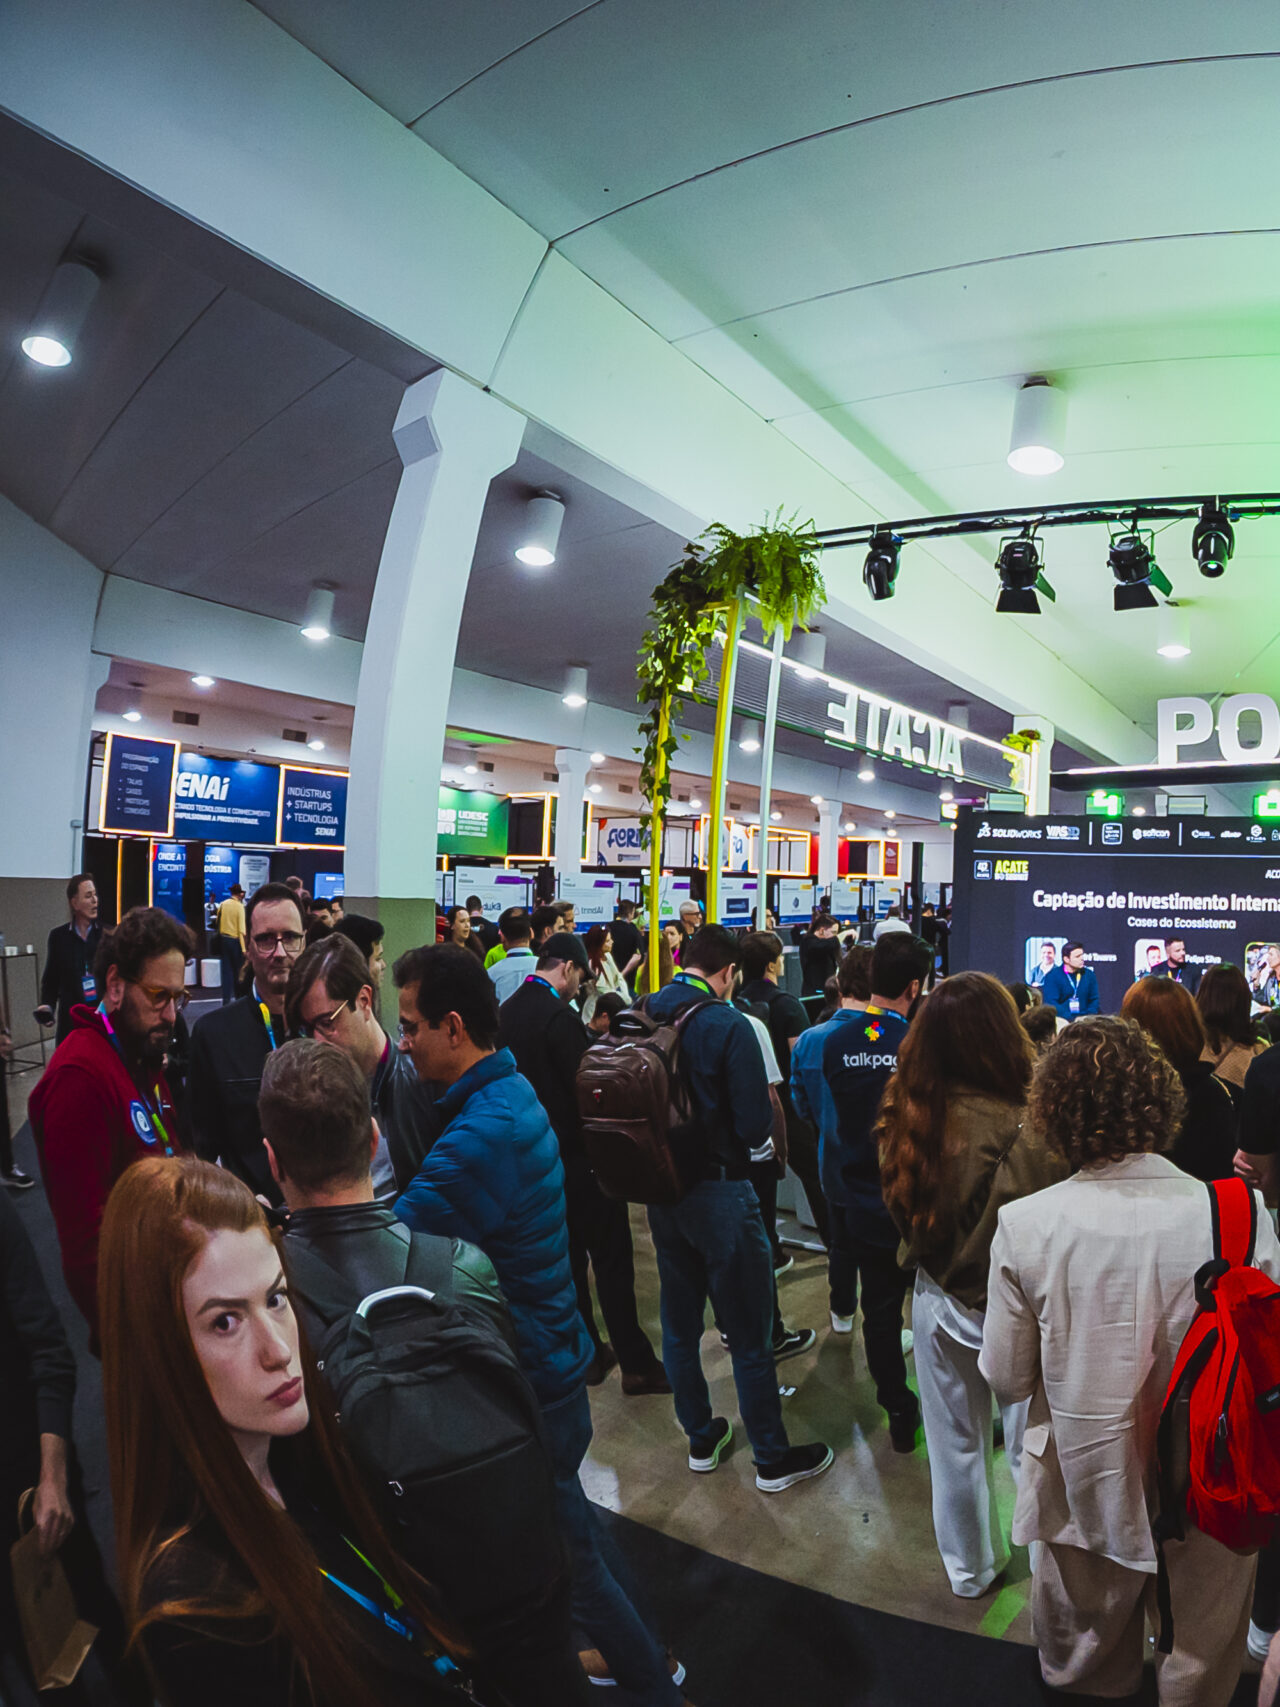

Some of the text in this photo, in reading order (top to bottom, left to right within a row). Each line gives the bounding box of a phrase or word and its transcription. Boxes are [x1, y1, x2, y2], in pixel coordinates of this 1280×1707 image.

[287, 786, 332, 800] INDÚSTRIAS
[294, 800, 333, 812] STARTUPS
[294, 812, 339, 825] TECNOLOGIA
[992, 828, 1042, 839] SOLIDWORKS
[995, 860, 1029, 874] ACATE
[1033, 889, 1104, 911] Captação
[1106, 892, 1125, 909] de
[1128, 892, 1228, 911] Investimento
[1127, 916, 1236, 929] Cases do Ecossistema
